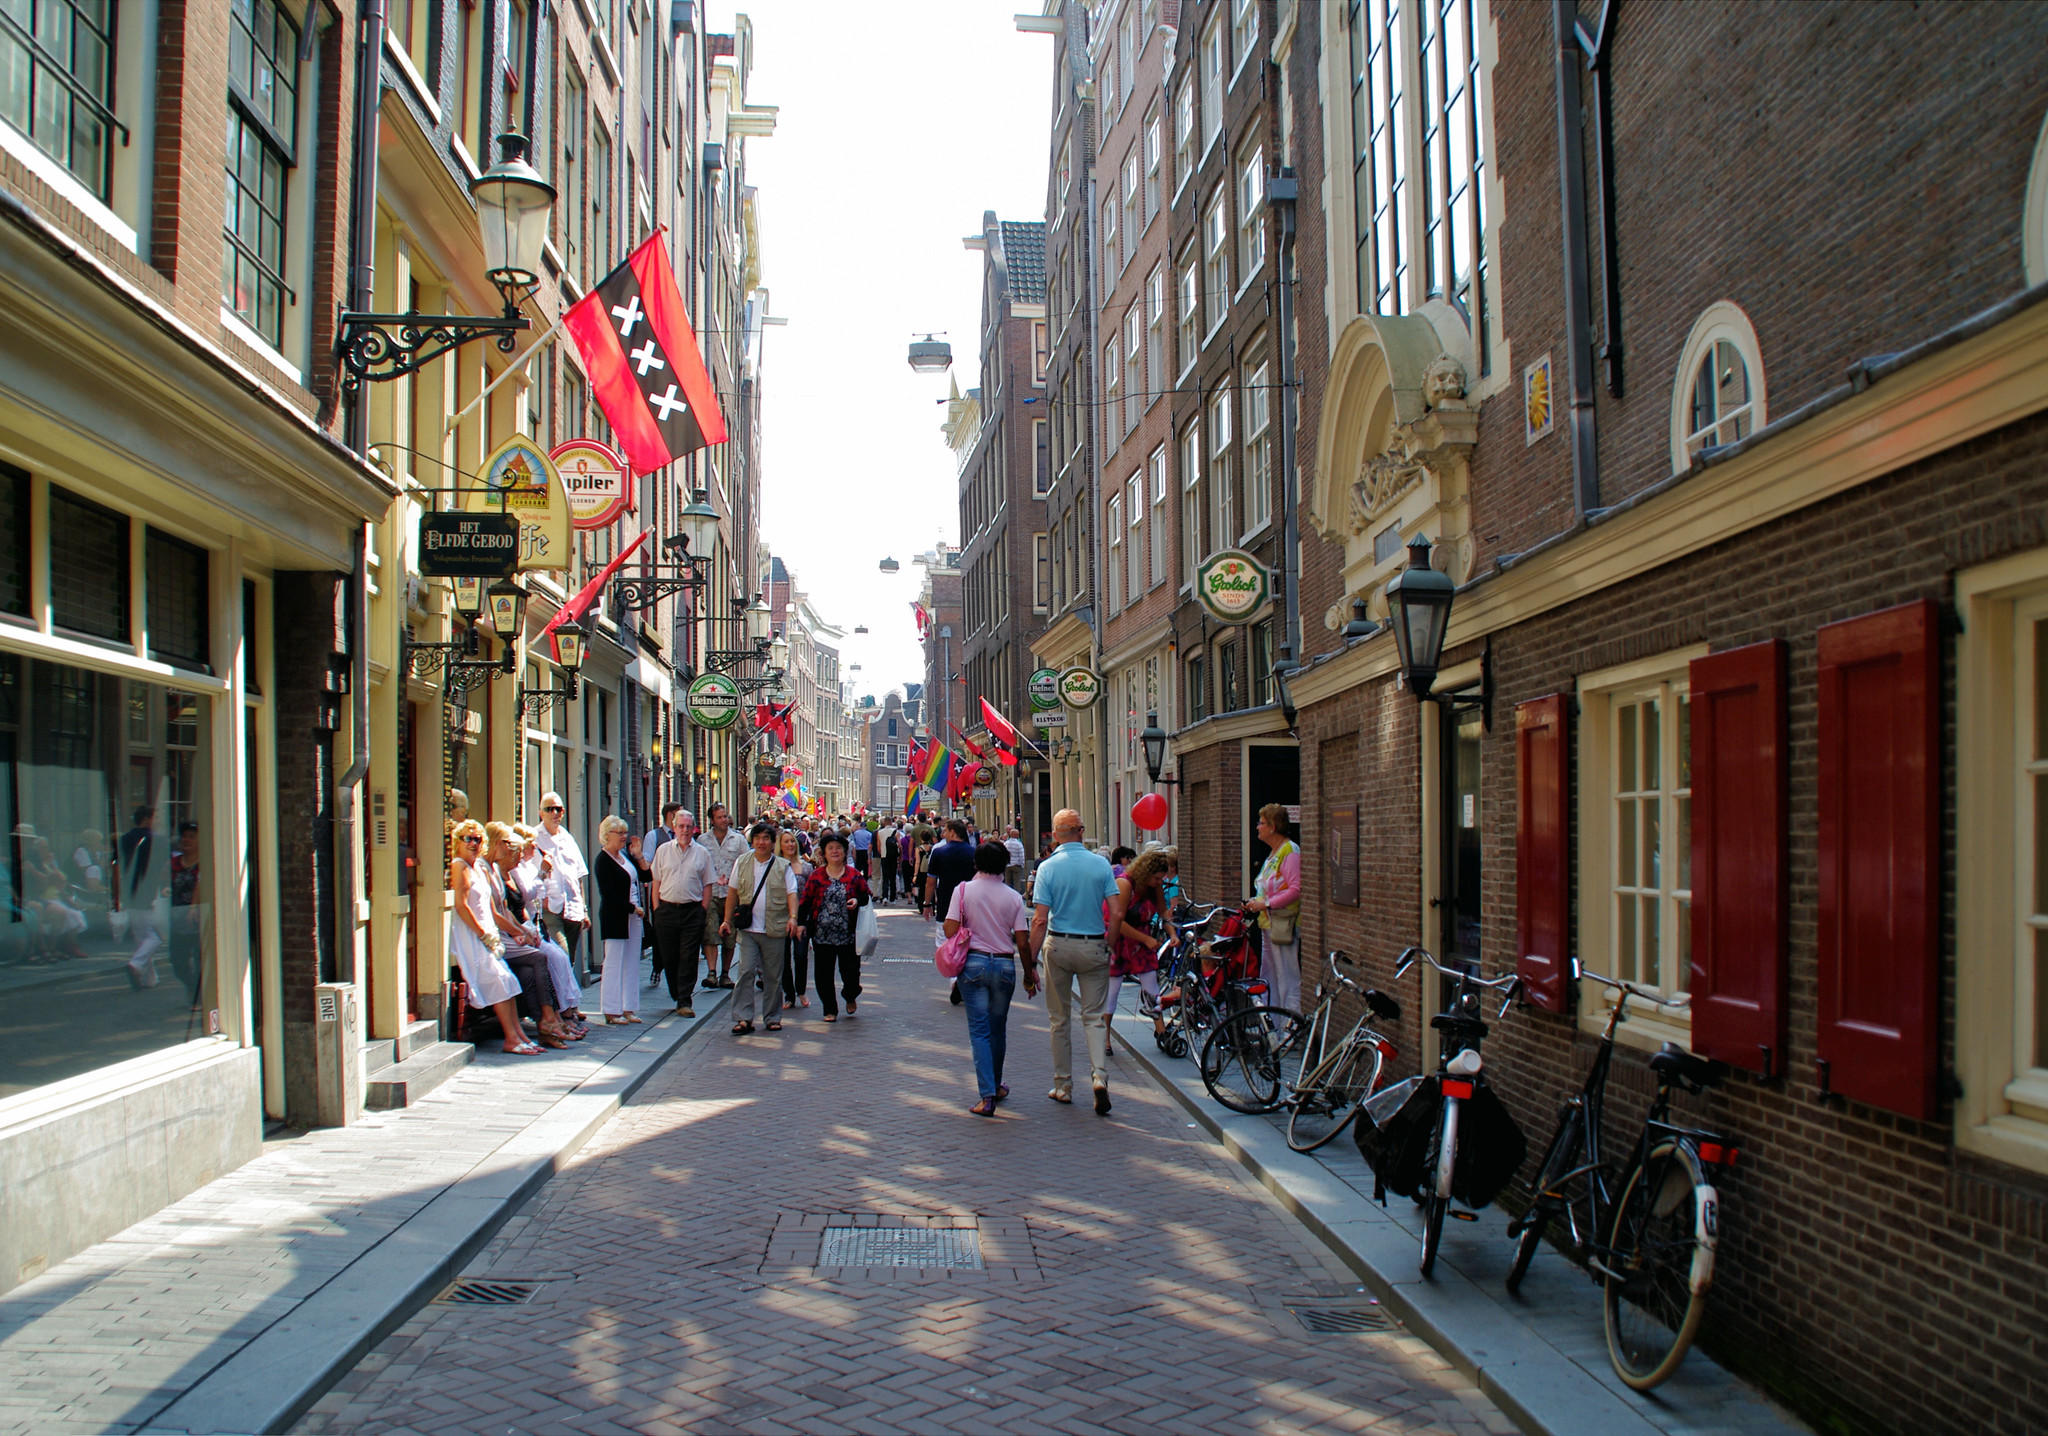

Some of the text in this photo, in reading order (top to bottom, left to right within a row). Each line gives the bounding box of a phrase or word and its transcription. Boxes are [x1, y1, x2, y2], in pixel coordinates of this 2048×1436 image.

[567, 475, 614, 492] piler
[460, 522, 480, 533] HET
[426, 530, 514, 550] ELFDE GEBOD
[518, 524, 550, 561] ffe
[1208, 573, 1257, 593] Grolsch
[1064, 681, 1095, 693] Grolsch
[691, 696, 736, 705] Heineken
[320, 997, 336, 1020] BNE
